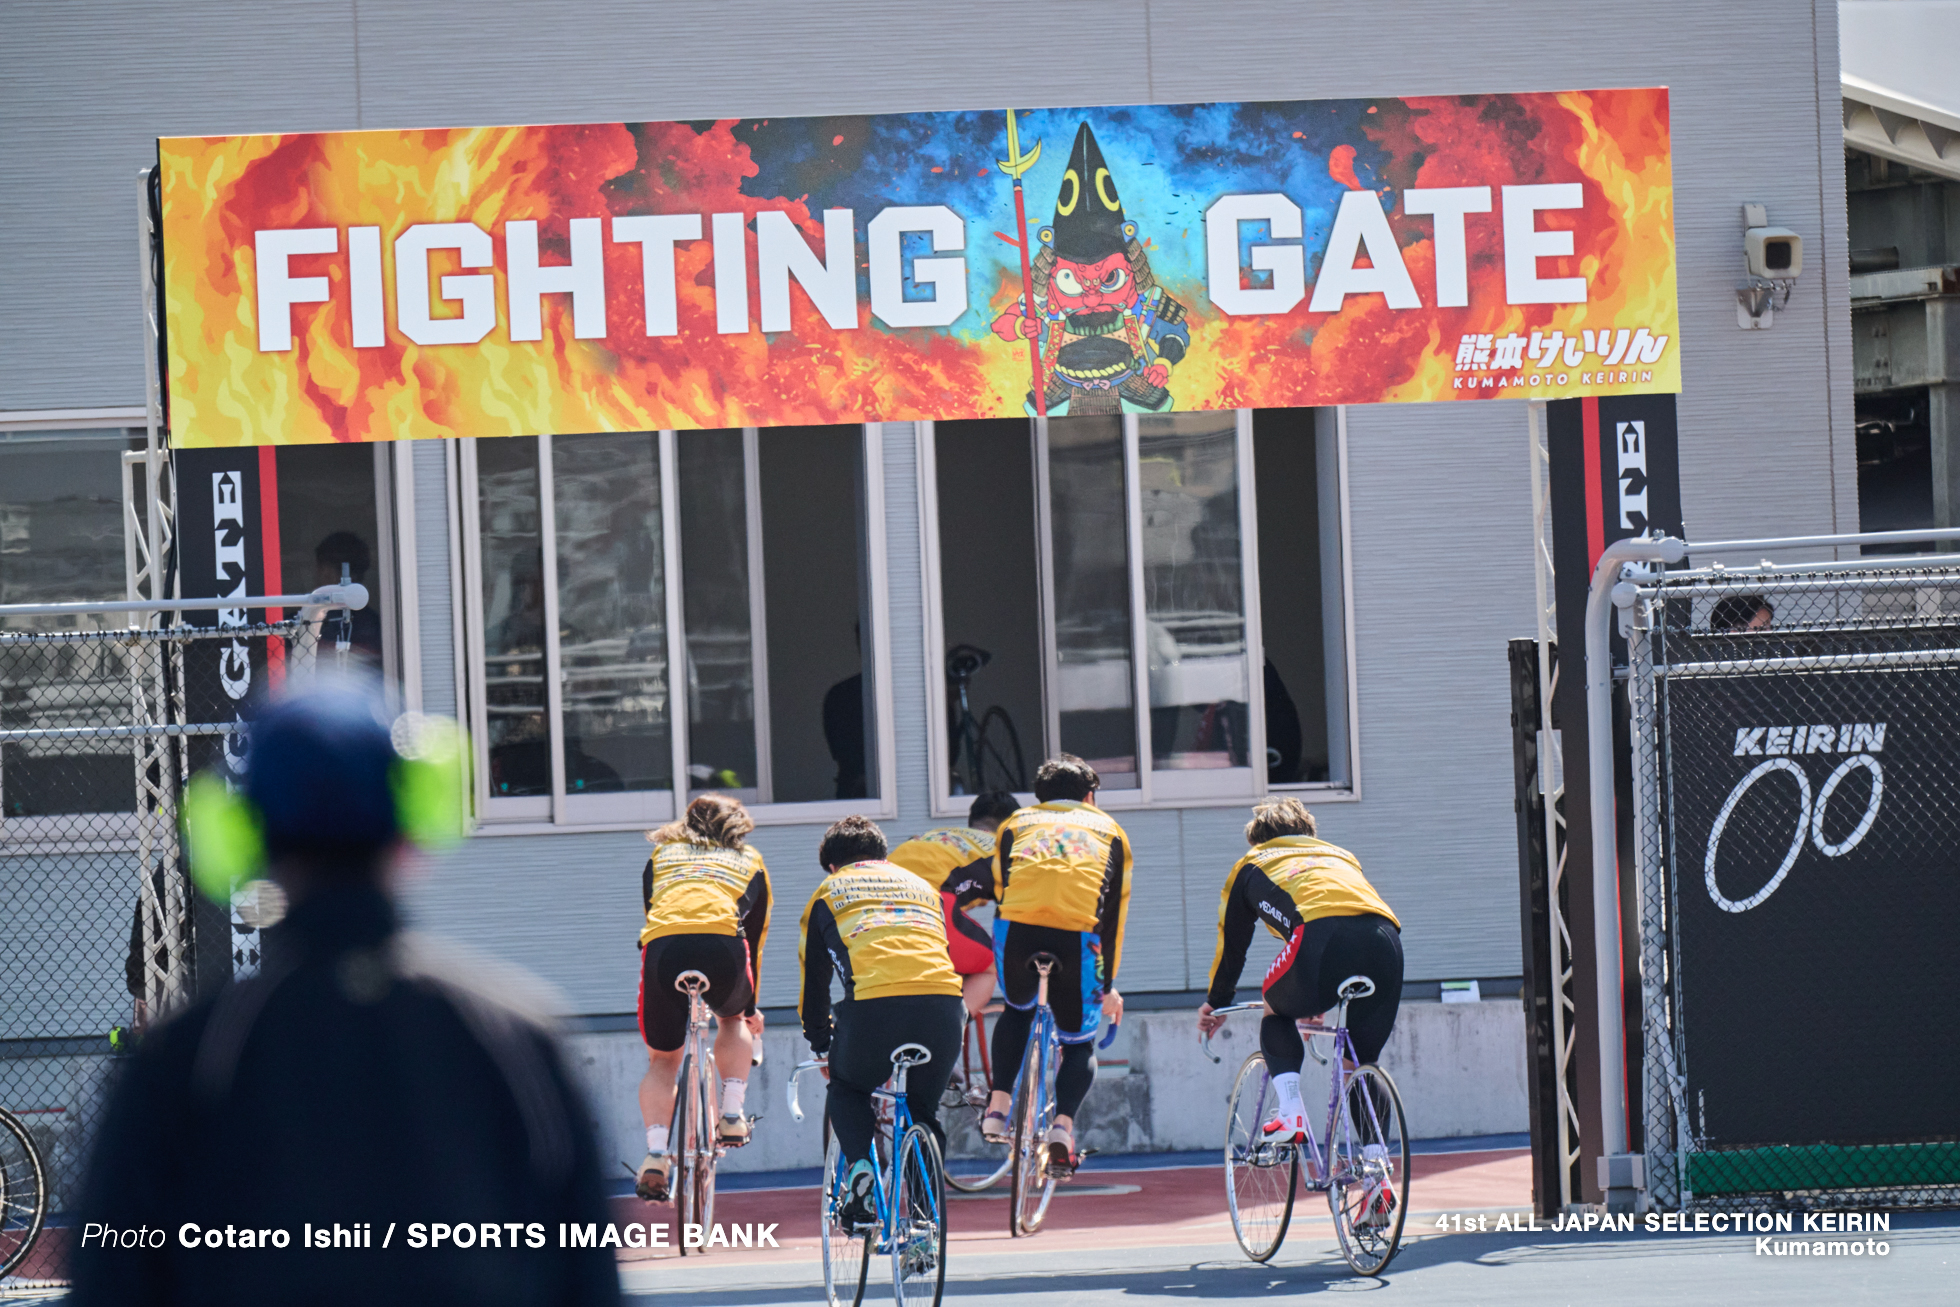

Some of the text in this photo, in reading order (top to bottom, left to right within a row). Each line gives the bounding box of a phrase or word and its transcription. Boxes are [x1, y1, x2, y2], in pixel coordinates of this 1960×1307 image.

[254, 183, 1588, 352] FIGHTING GATE
[1455, 328, 1669, 372] 熊本けいりん
[1453, 371, 1652, 389] KUMAMOTO KEIRIN
[1733, 722, 1887, 757] KEIRIN
